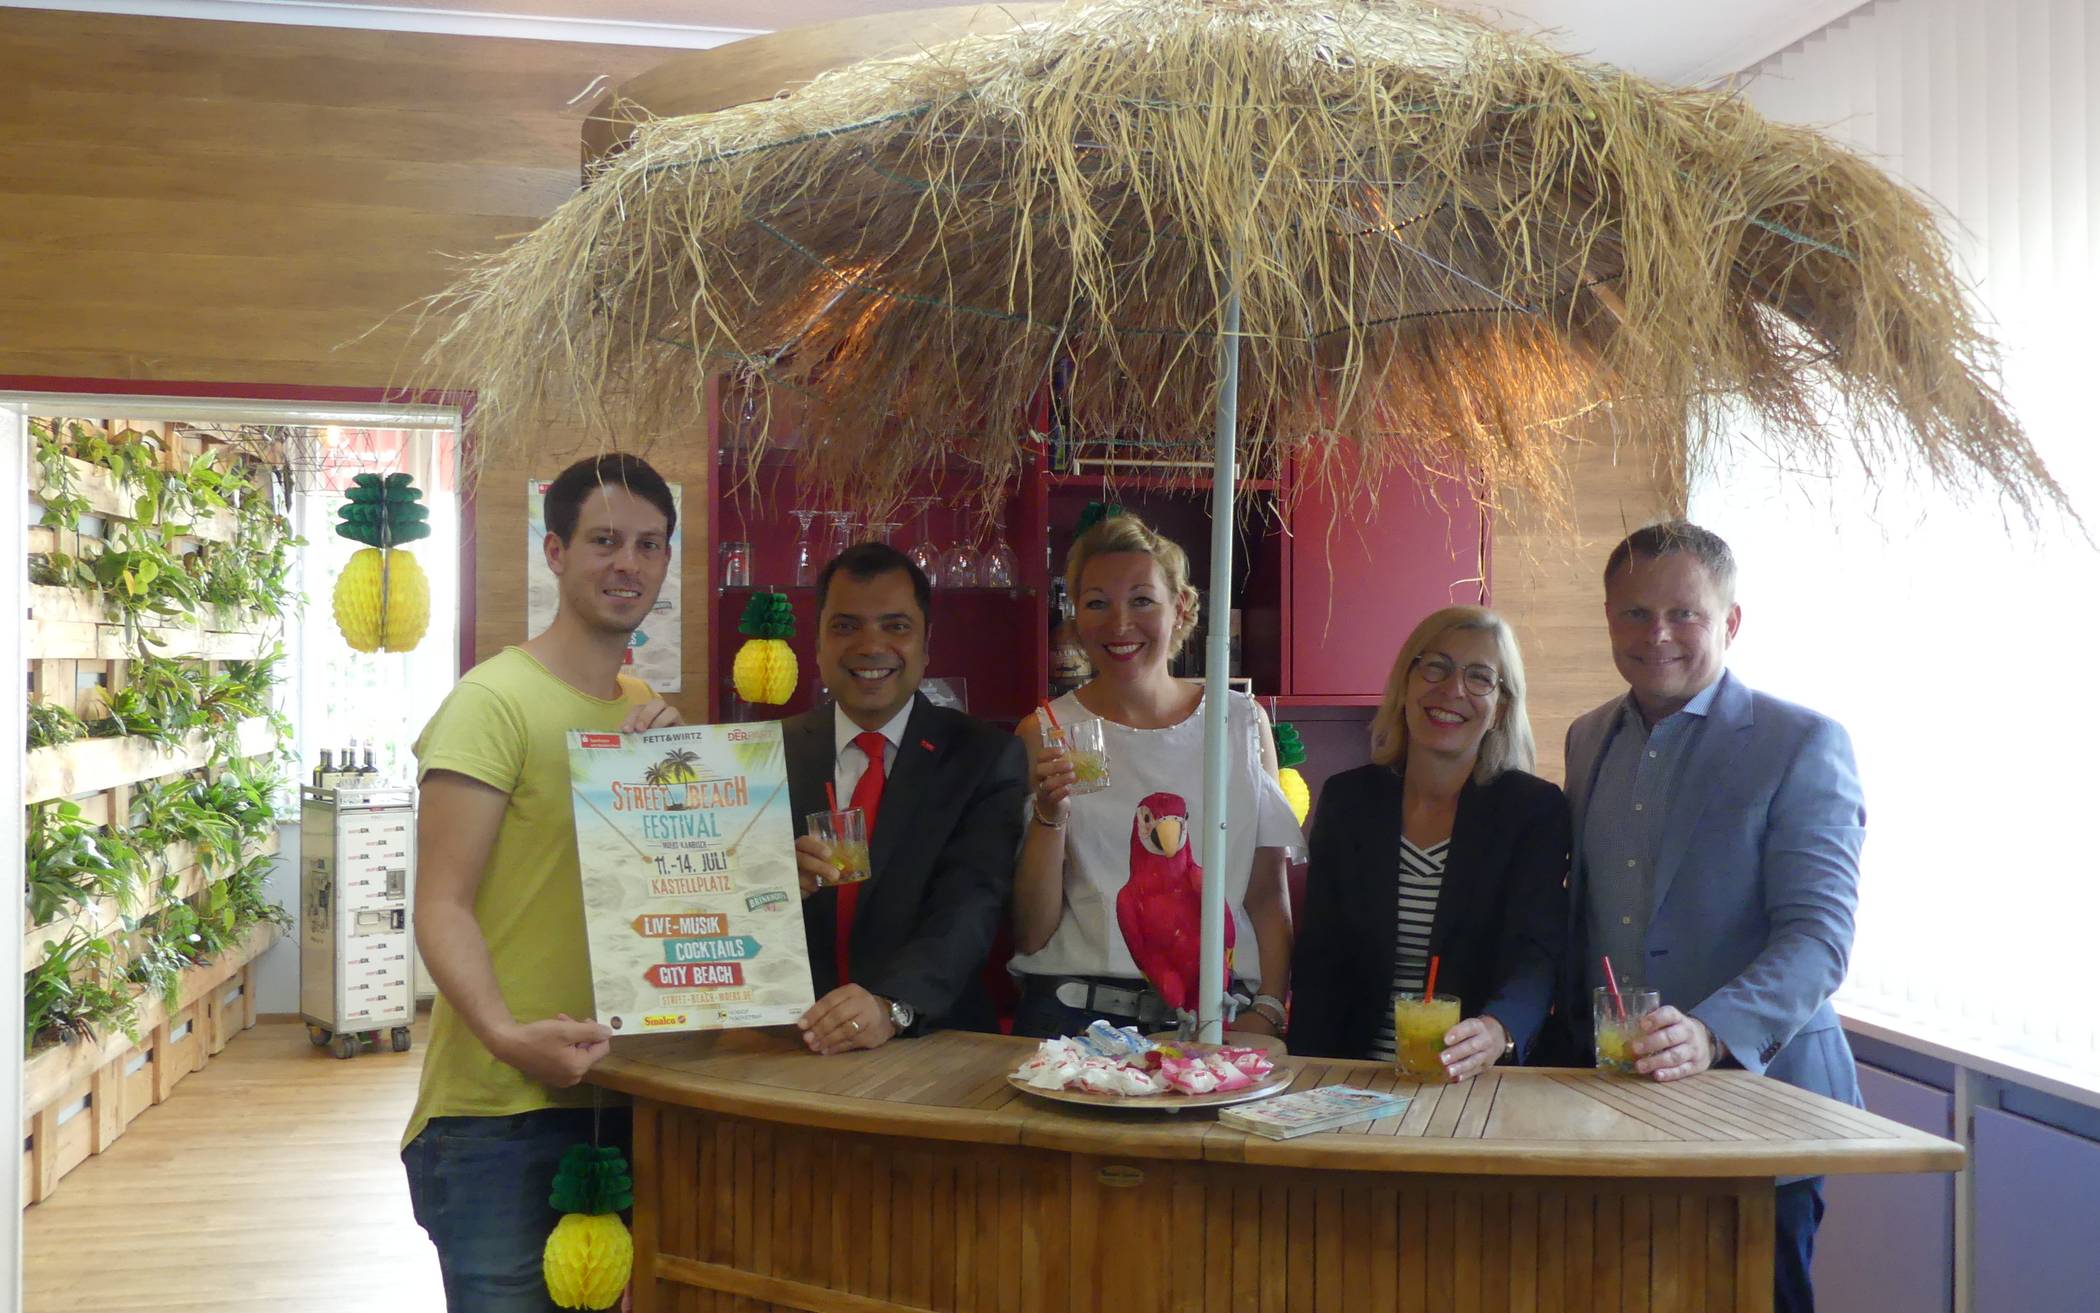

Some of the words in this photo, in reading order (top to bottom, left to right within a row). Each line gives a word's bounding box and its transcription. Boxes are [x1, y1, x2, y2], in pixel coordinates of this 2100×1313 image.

[643, 732, 703, 744] FETT&WIRTZ
[611, 781, 669, 811] STREET
[687, 775, 749, 810] BEACH
[643, 812, 722, 840] FESTIVAL
[702, 851, 728, 872] JULI
[651, 875, 731, 895] KASTELLPLATZ
[644, 916, 721, 936] LIVE-MUSIK
[675, 939, 745, 961] COCKTAILS
[660, 966, 687, 985] CITY
[693, 966, 734, 985] BEACH
[644, 1016, 677, 1026] Sinalco
